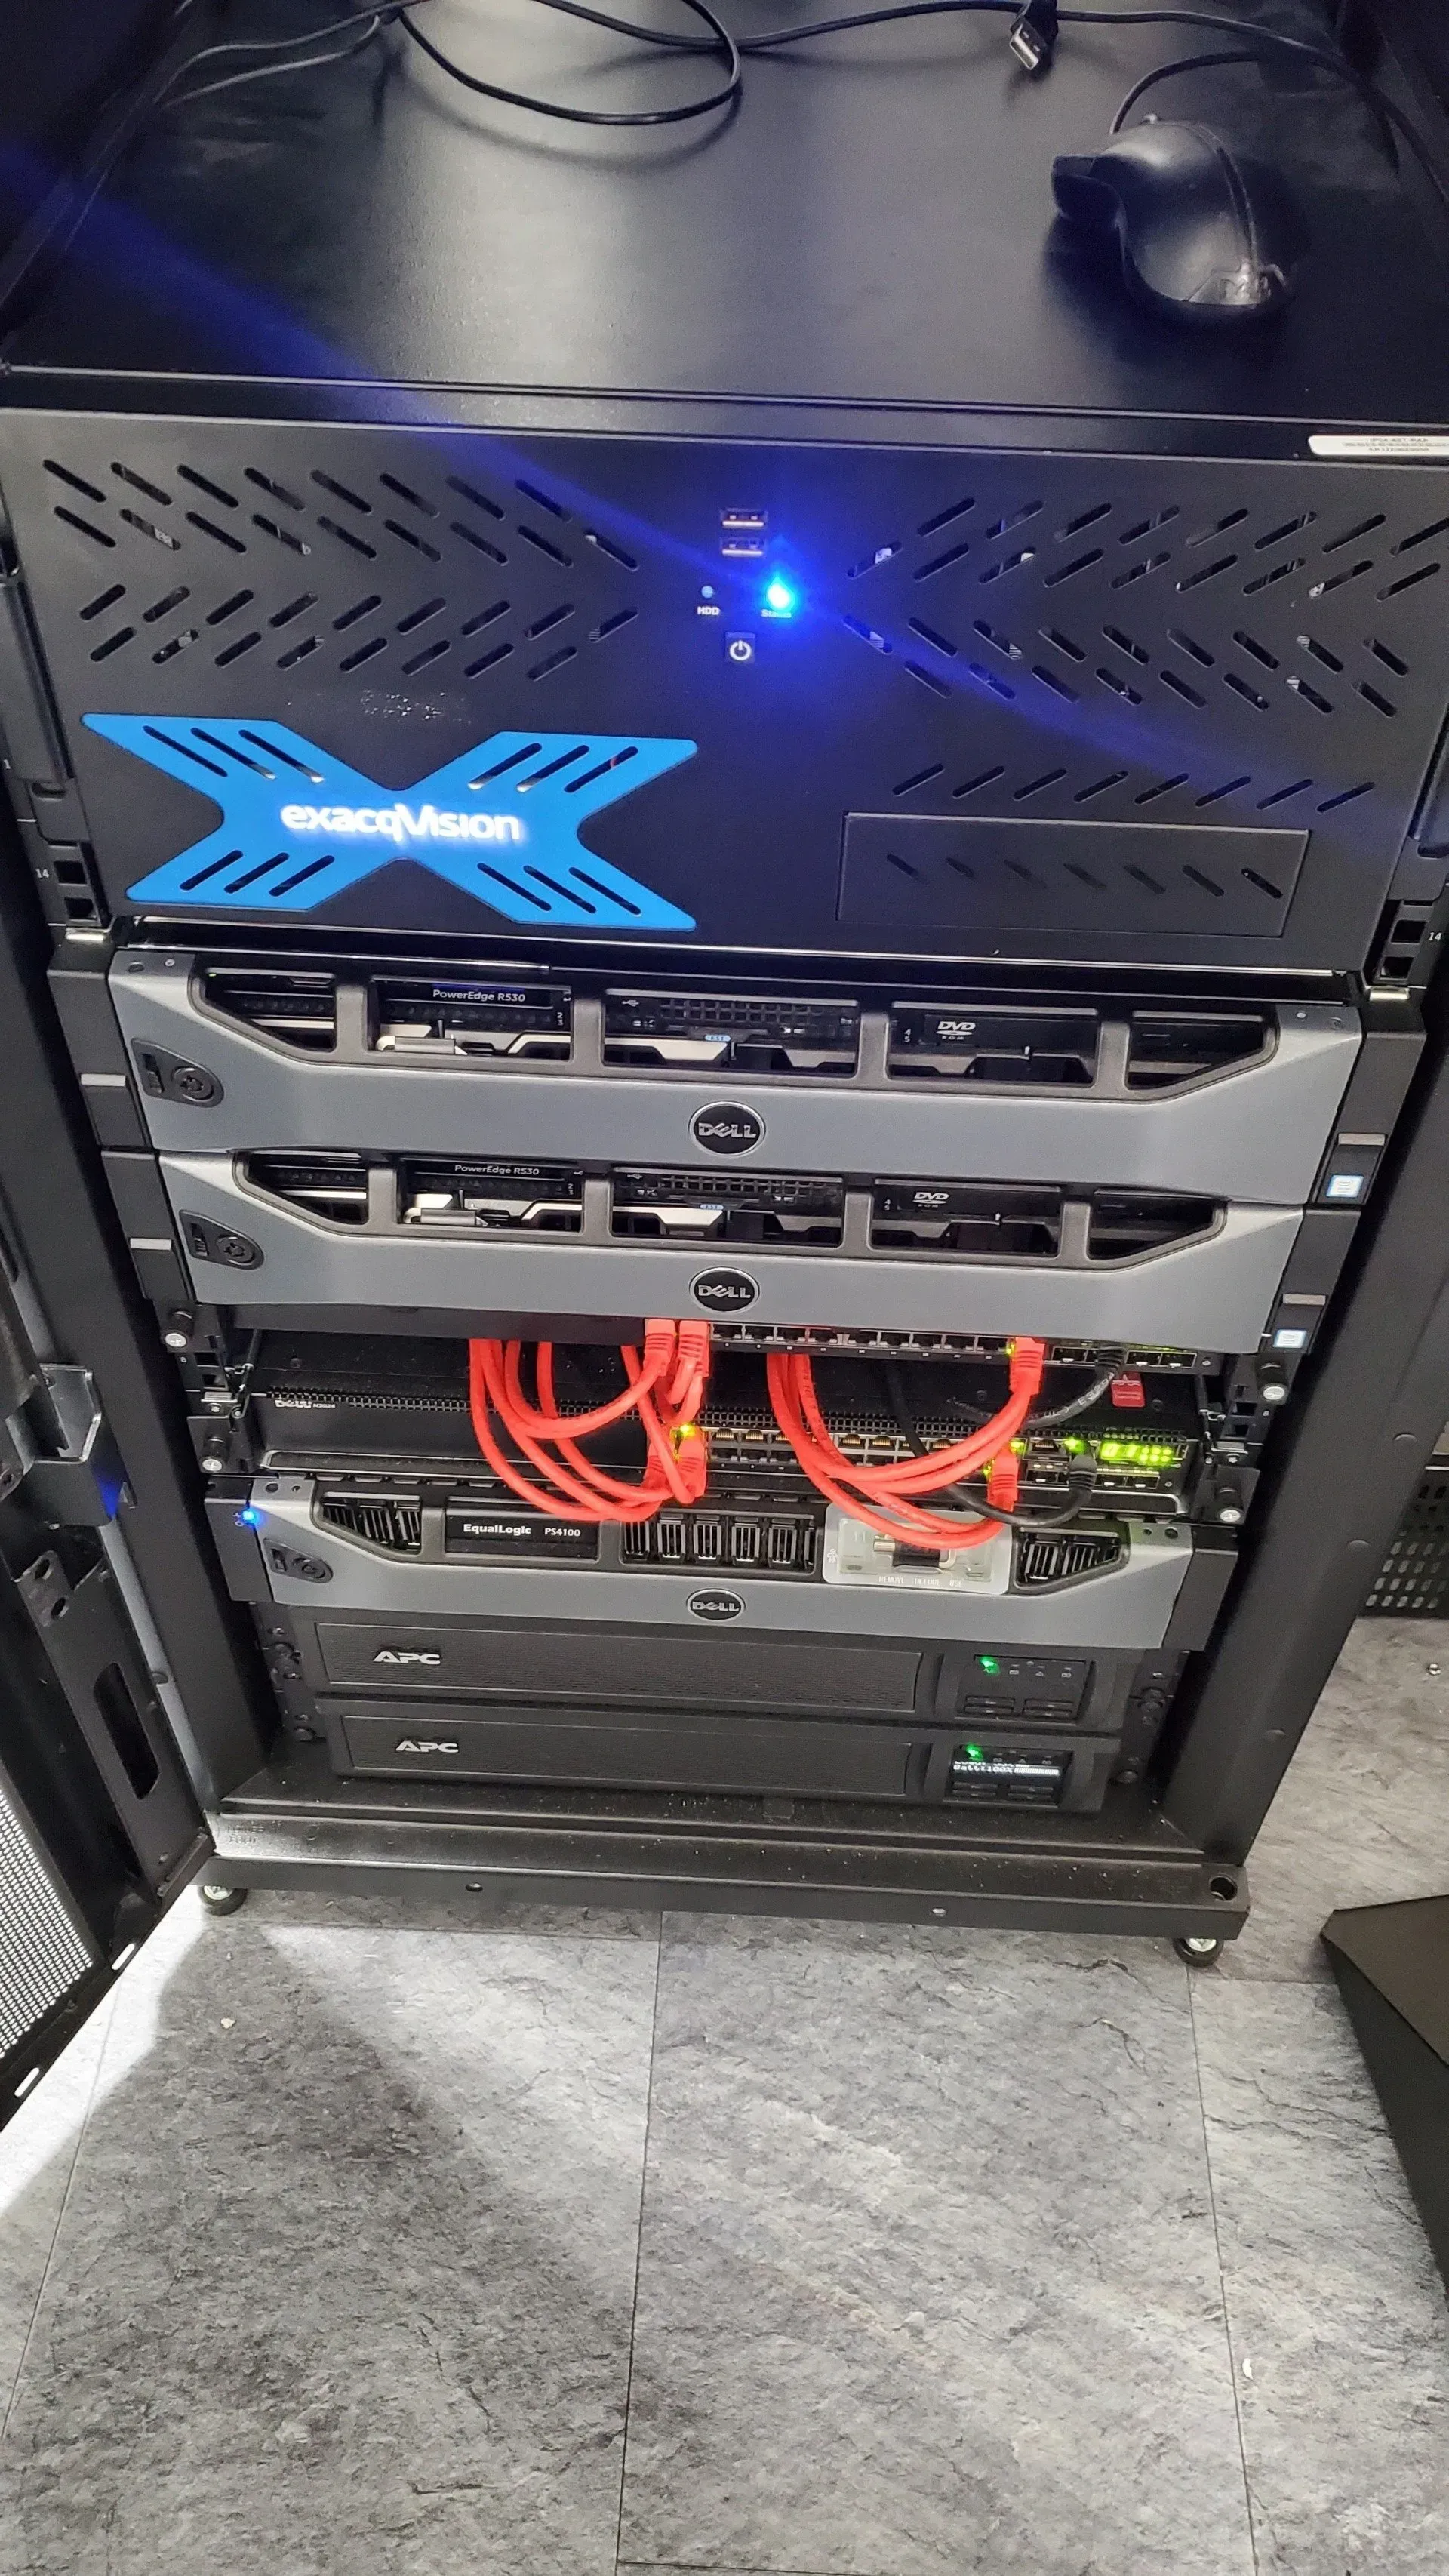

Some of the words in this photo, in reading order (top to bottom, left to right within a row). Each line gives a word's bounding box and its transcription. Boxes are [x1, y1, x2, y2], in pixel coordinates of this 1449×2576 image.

[697, 606, 721, 616] HDD
[281, 803, 521, 842] exacqVision
[35, 868, 50, 879] 14
[1427, 931, 1442, 942] 14
[432, 989, 495, 1002] PowerEdge
[497, 993, 526, 1002] R530
[937, 1020, 977, 1031] DVD
[697, 1122, 757, 1139] DELL
[454, 1165, 512, 1175] PowerEdge
[513, 1167, 540, 1176] R530
[914, 1192, 951, 1201] DVD
[697, 1284, 752, 1299] DELL
[463, 1523, 532, 1537] EqualLogic
[544, 1527, 581, 1537] PS4100
[692, 1601, 740, 1612] DELL
[373, 1651, 441, 1665] APC
[395, 1740, 459, 1753] APC
